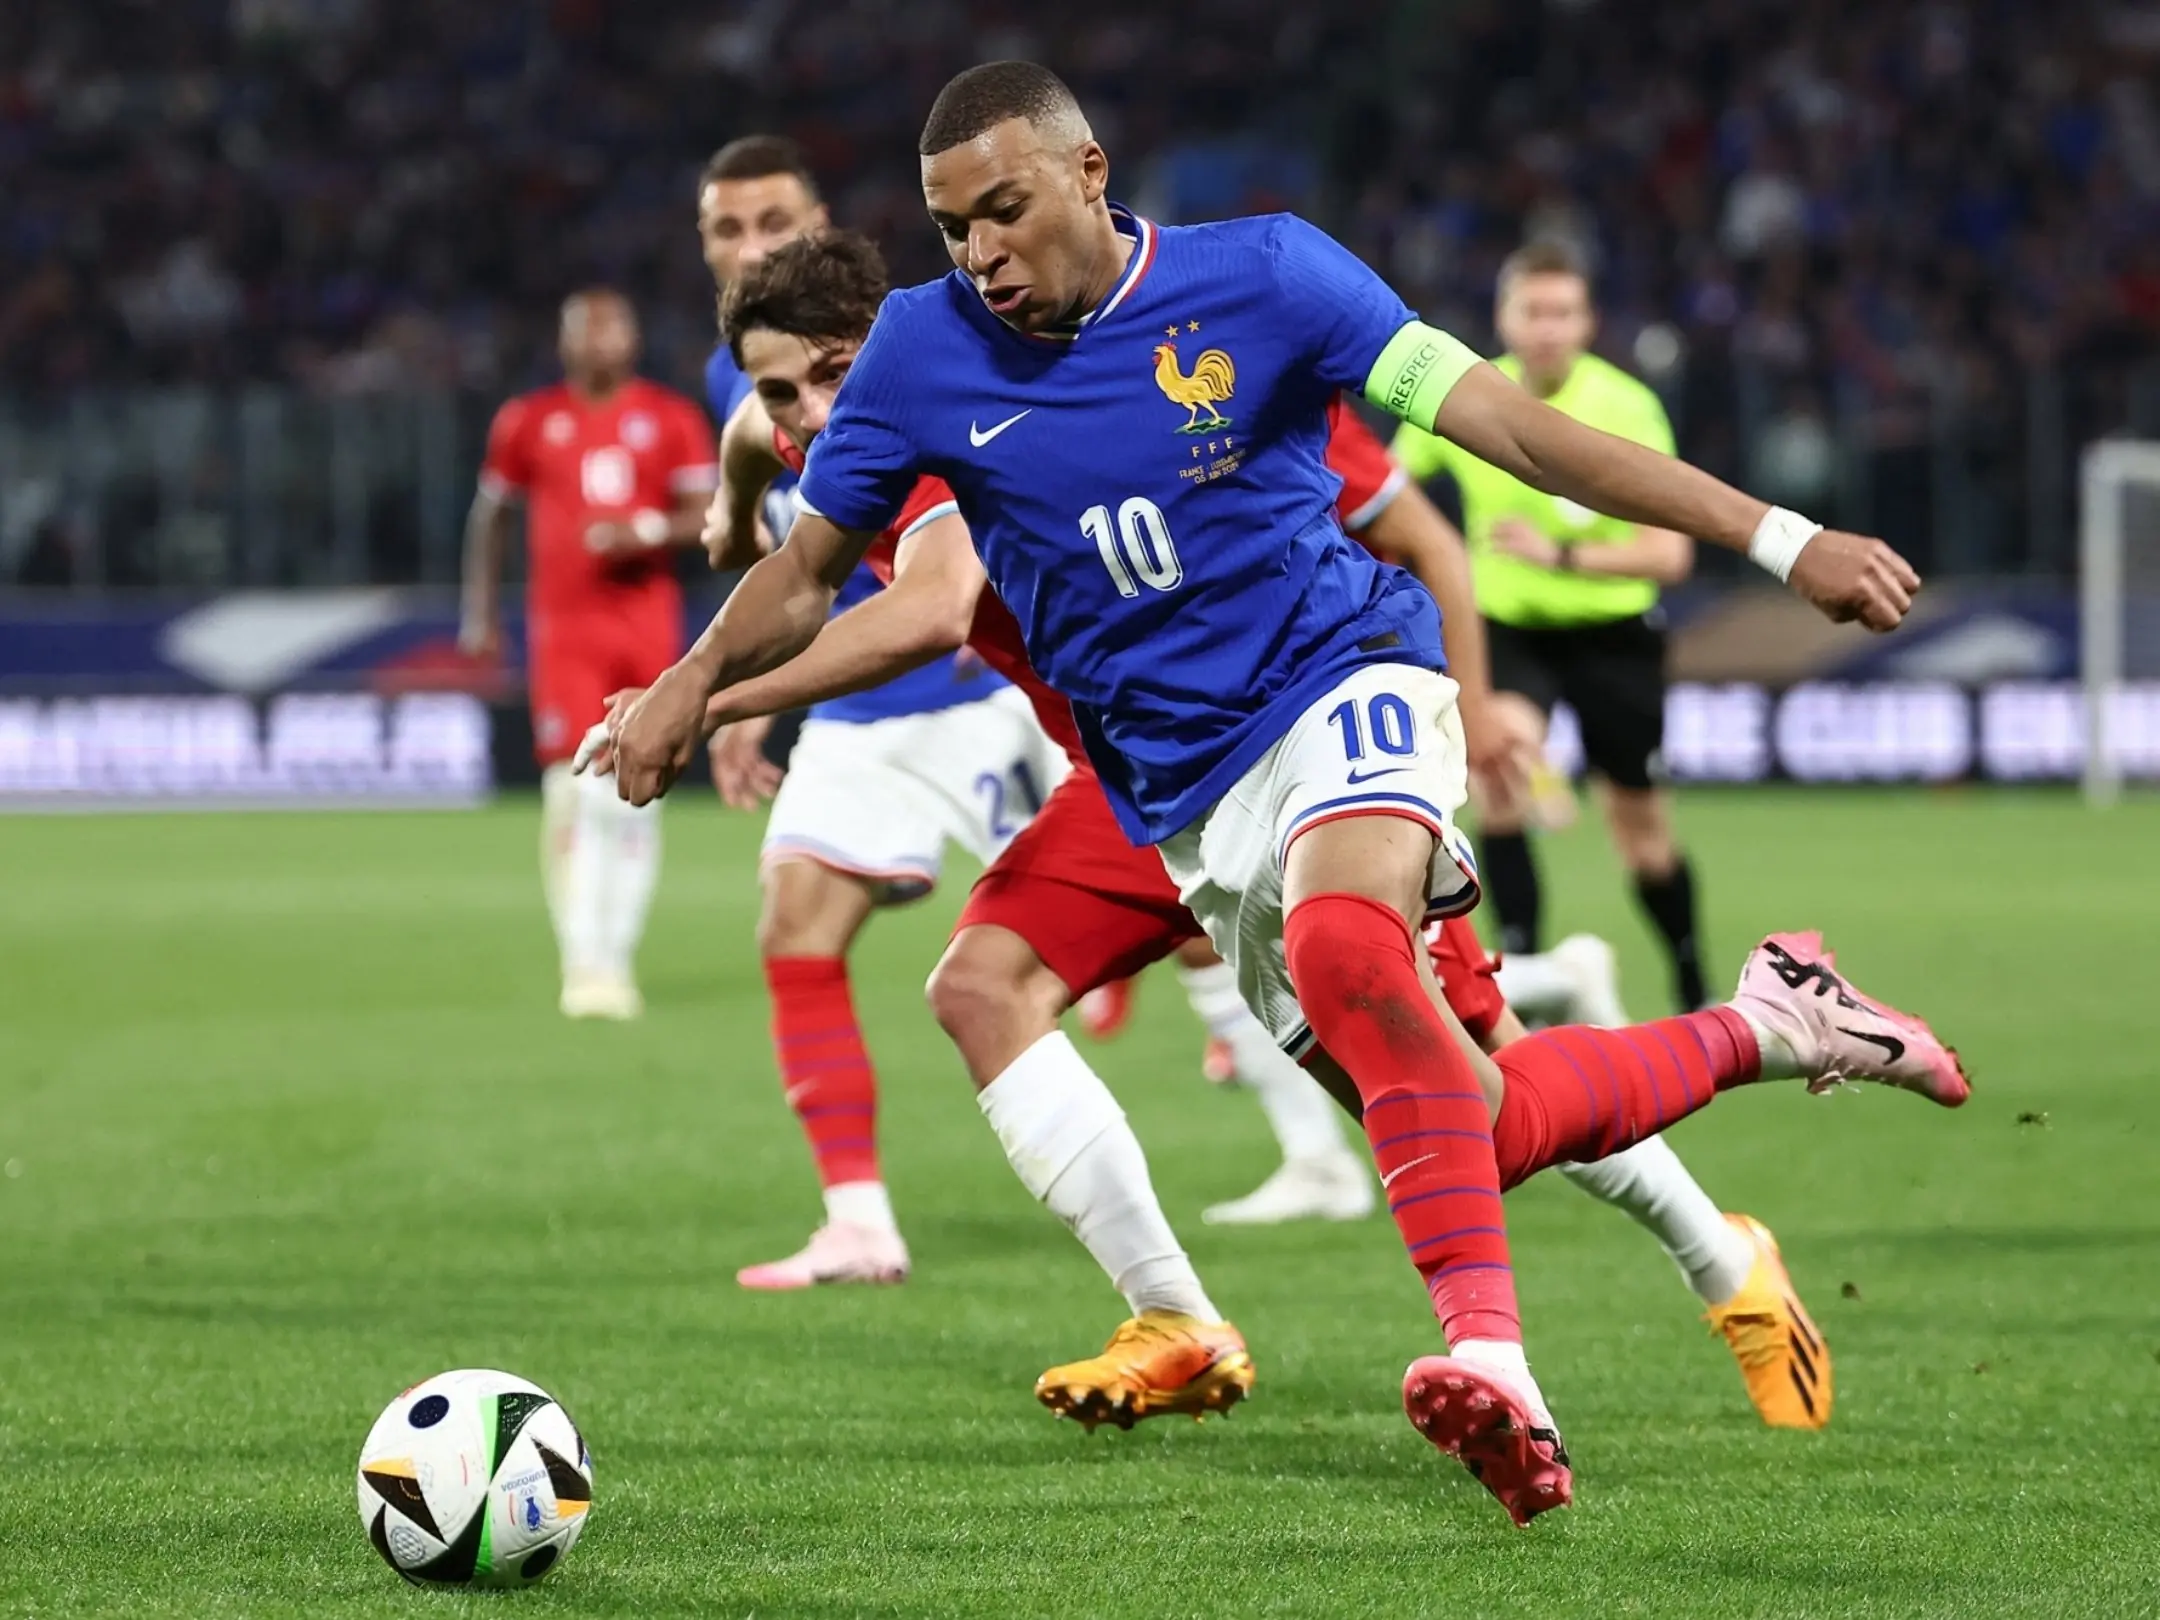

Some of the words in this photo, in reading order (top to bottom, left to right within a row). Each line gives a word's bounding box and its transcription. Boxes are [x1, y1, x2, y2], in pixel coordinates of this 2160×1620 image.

[1392, 342, 1439, 409] RESPECT
[1079, 496, 1183, 598] 10
[1328, 693, 1418, 761] 10
[973, 757, 1042, 839] 21
